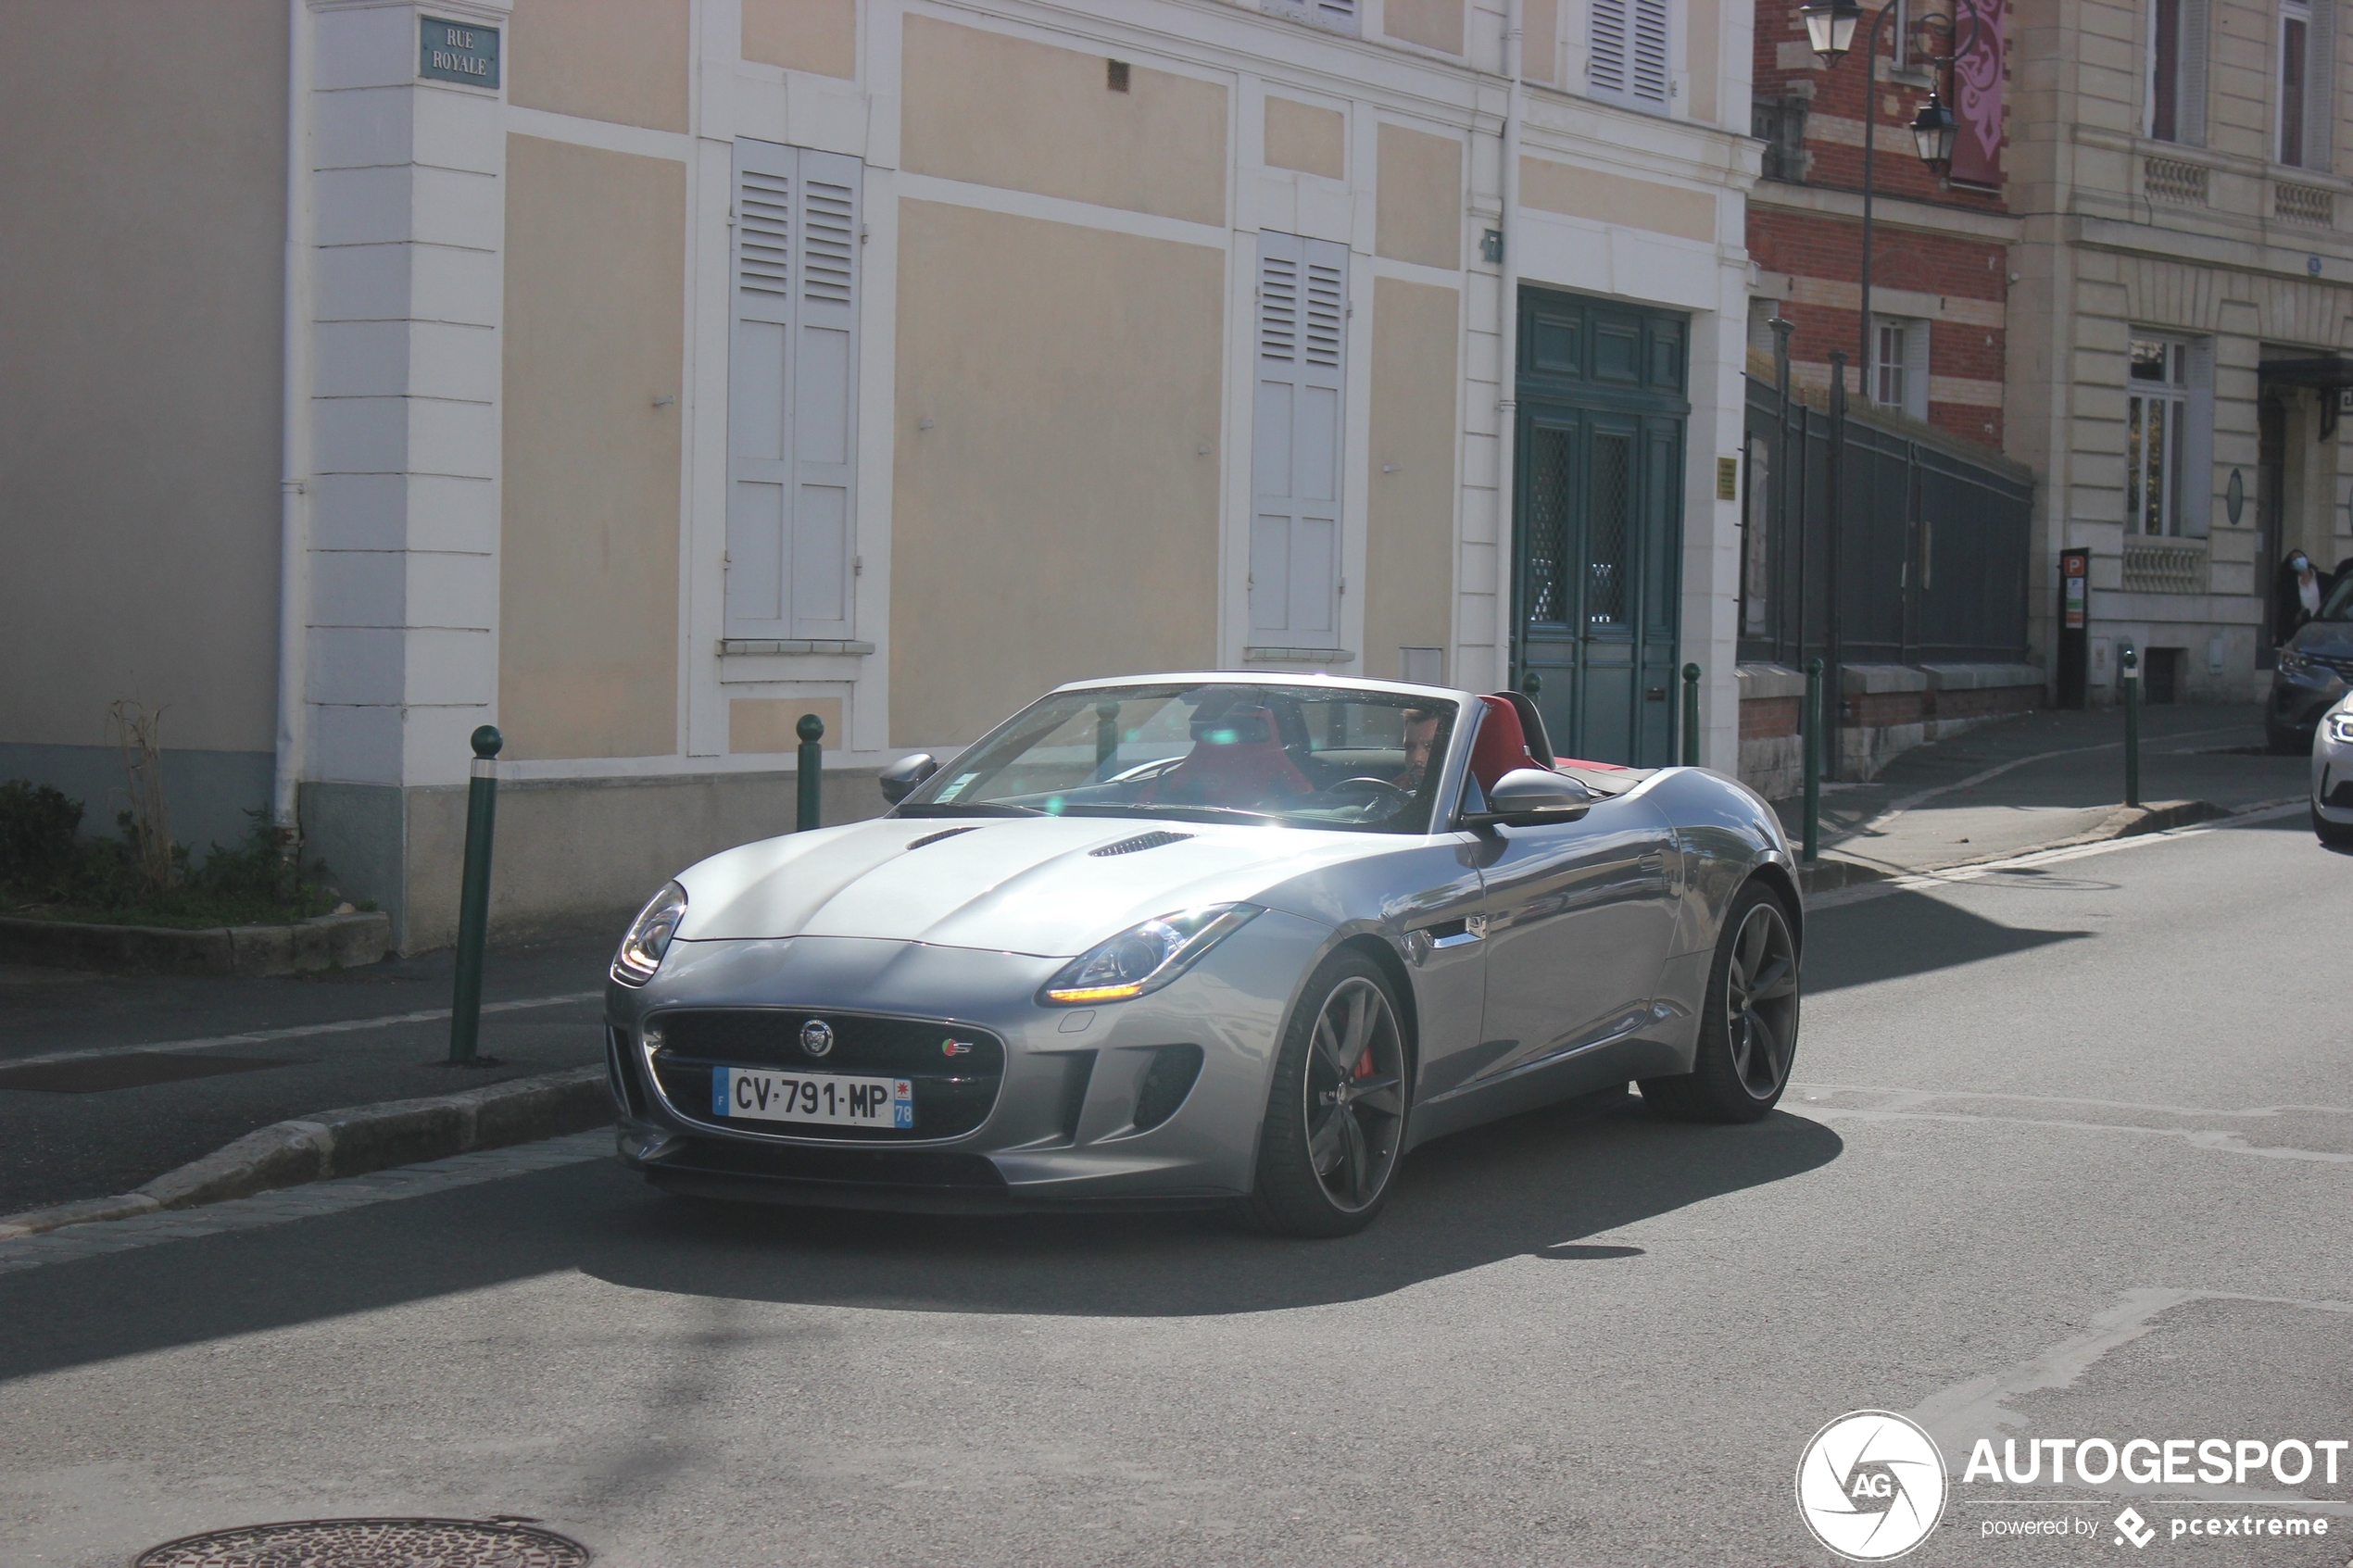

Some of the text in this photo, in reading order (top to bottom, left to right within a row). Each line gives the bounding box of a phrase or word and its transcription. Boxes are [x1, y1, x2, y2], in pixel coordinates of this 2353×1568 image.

[447, 28, 473, 49] RUE
[433, 50, 486, 76] ROYALE
[2069, 558, 2081, 573] P
[718, 1096, 724, 1106] F
[895, 1105, 912, 1123] 78
